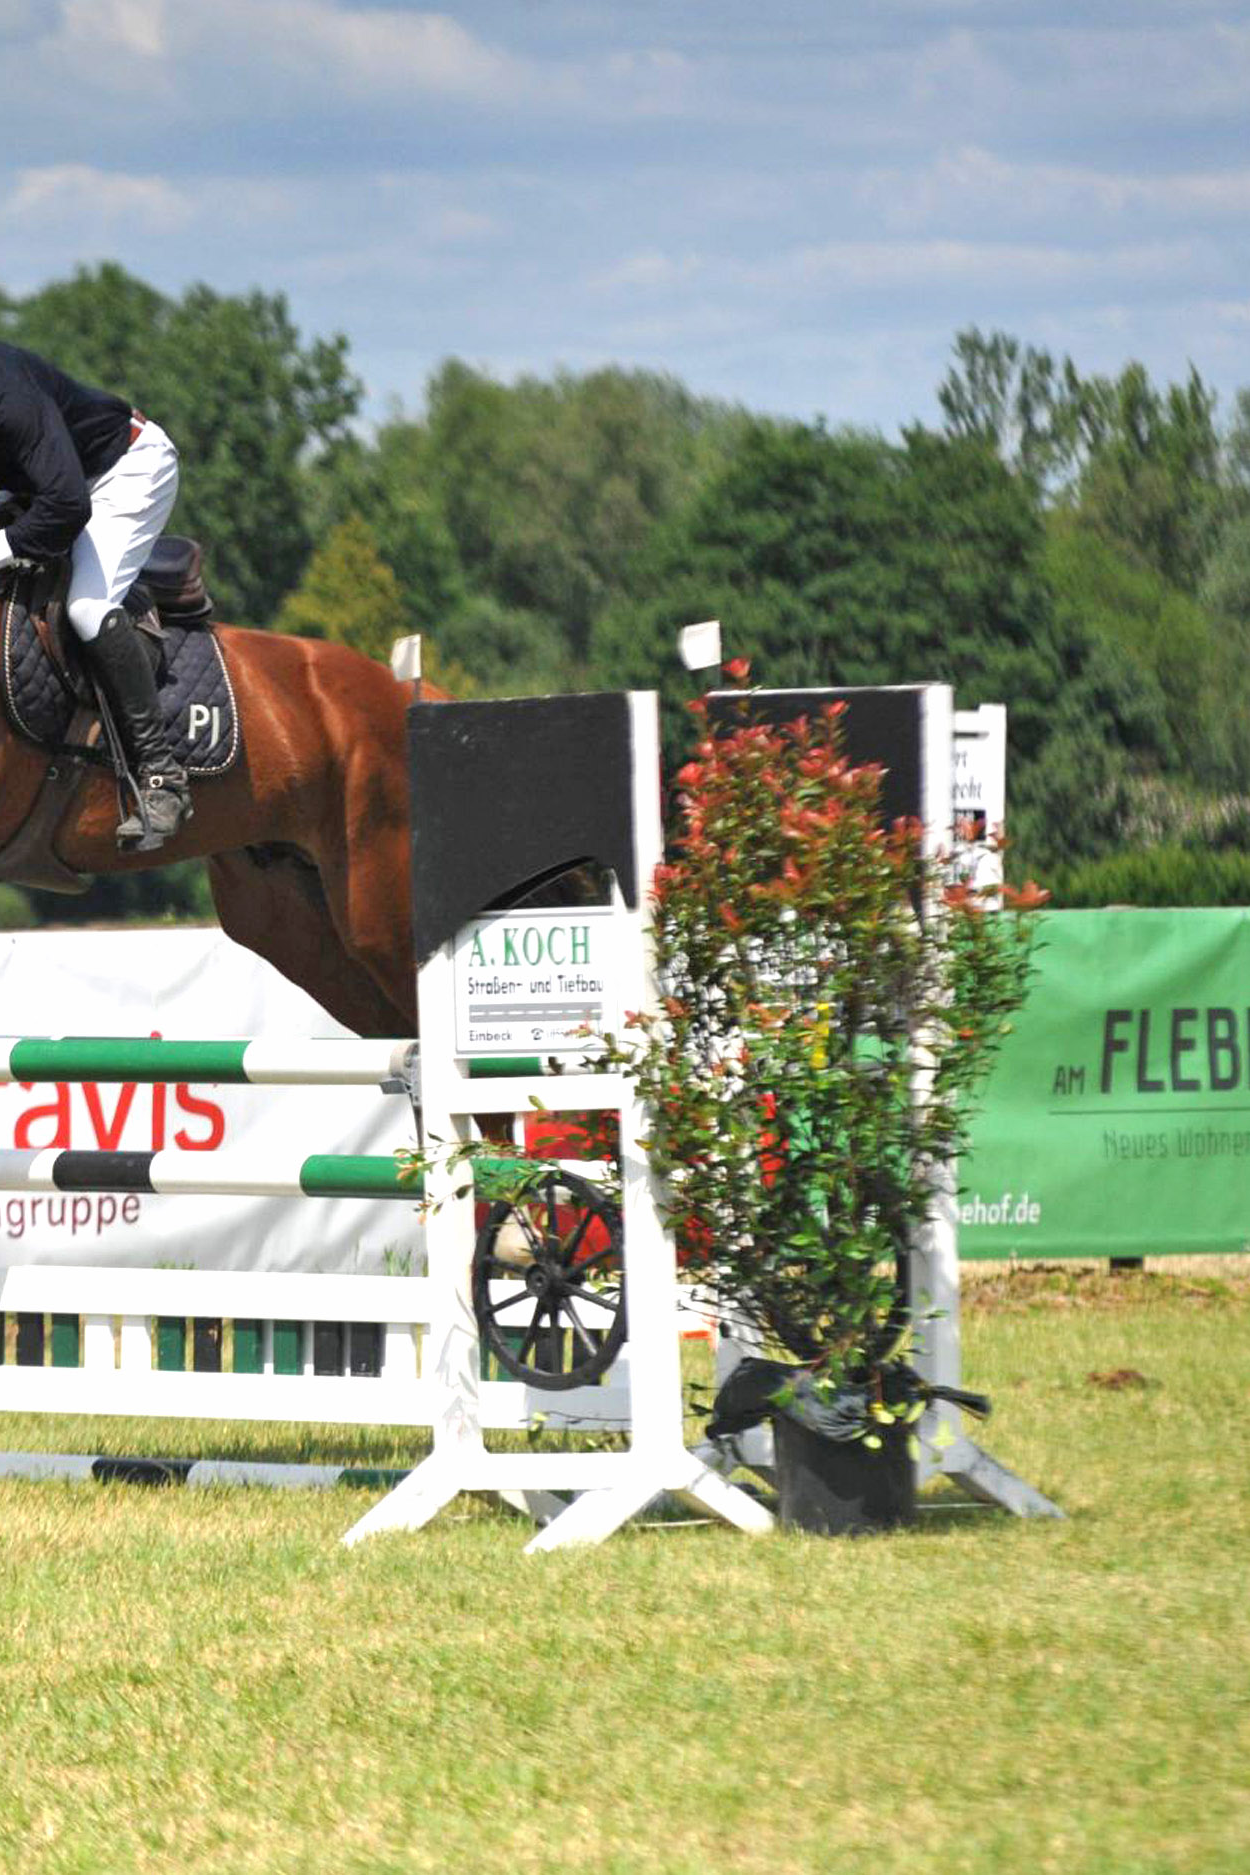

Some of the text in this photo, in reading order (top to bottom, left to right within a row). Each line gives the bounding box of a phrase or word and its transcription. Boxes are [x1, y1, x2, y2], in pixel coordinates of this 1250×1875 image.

[467, 974, 604, 995] Straßen- und Tiefbau
[468, 1029, 513, 1042] Einbeck
[1052, 1007, 1250, 1096] AM FLEB
[1103, 1129, 1169, 1160] Neues
